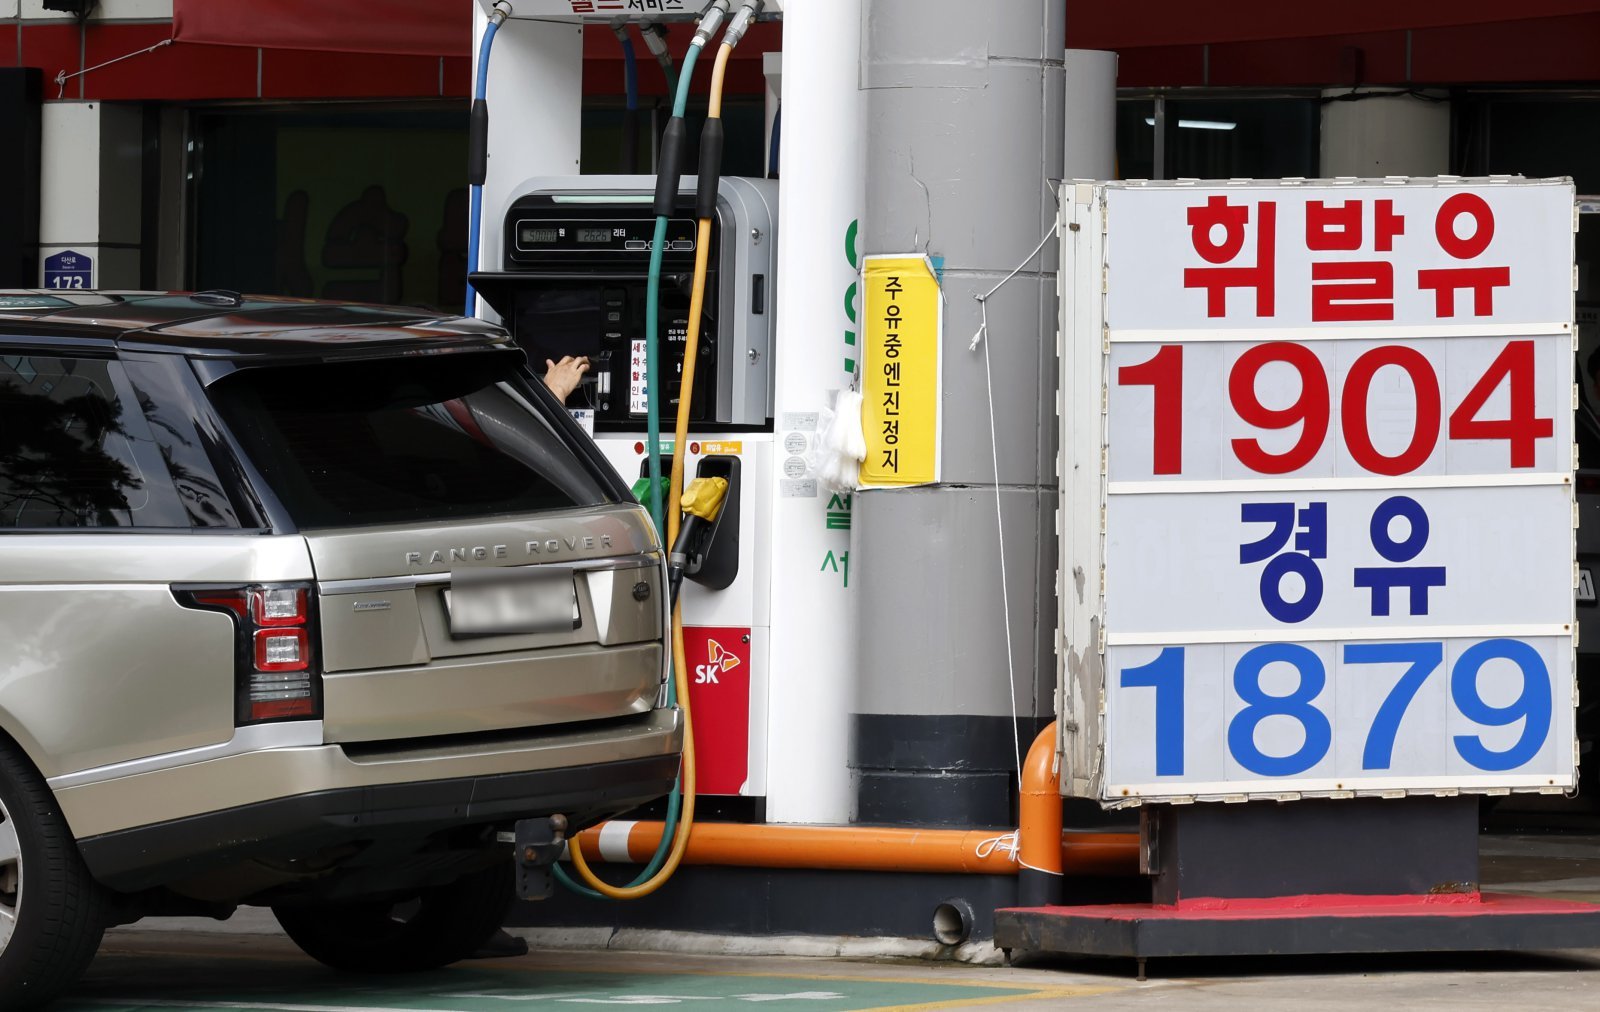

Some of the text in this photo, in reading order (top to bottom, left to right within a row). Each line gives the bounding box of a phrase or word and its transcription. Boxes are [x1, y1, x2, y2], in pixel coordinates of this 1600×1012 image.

[613, 228, 626, 237] 리터
[1184, 193, 1510, 321] 휘발유
[882, 276, 903, 473] 주유중엔진정지
[1118, 341, 1553, 476] 1904
[406, 534, 612, 566] RANGE ROVER
[1240, 496, 1446, 623] 경유
[695, 664, 719, 684] SK
[1120, 638, 1552, 776] 1879
